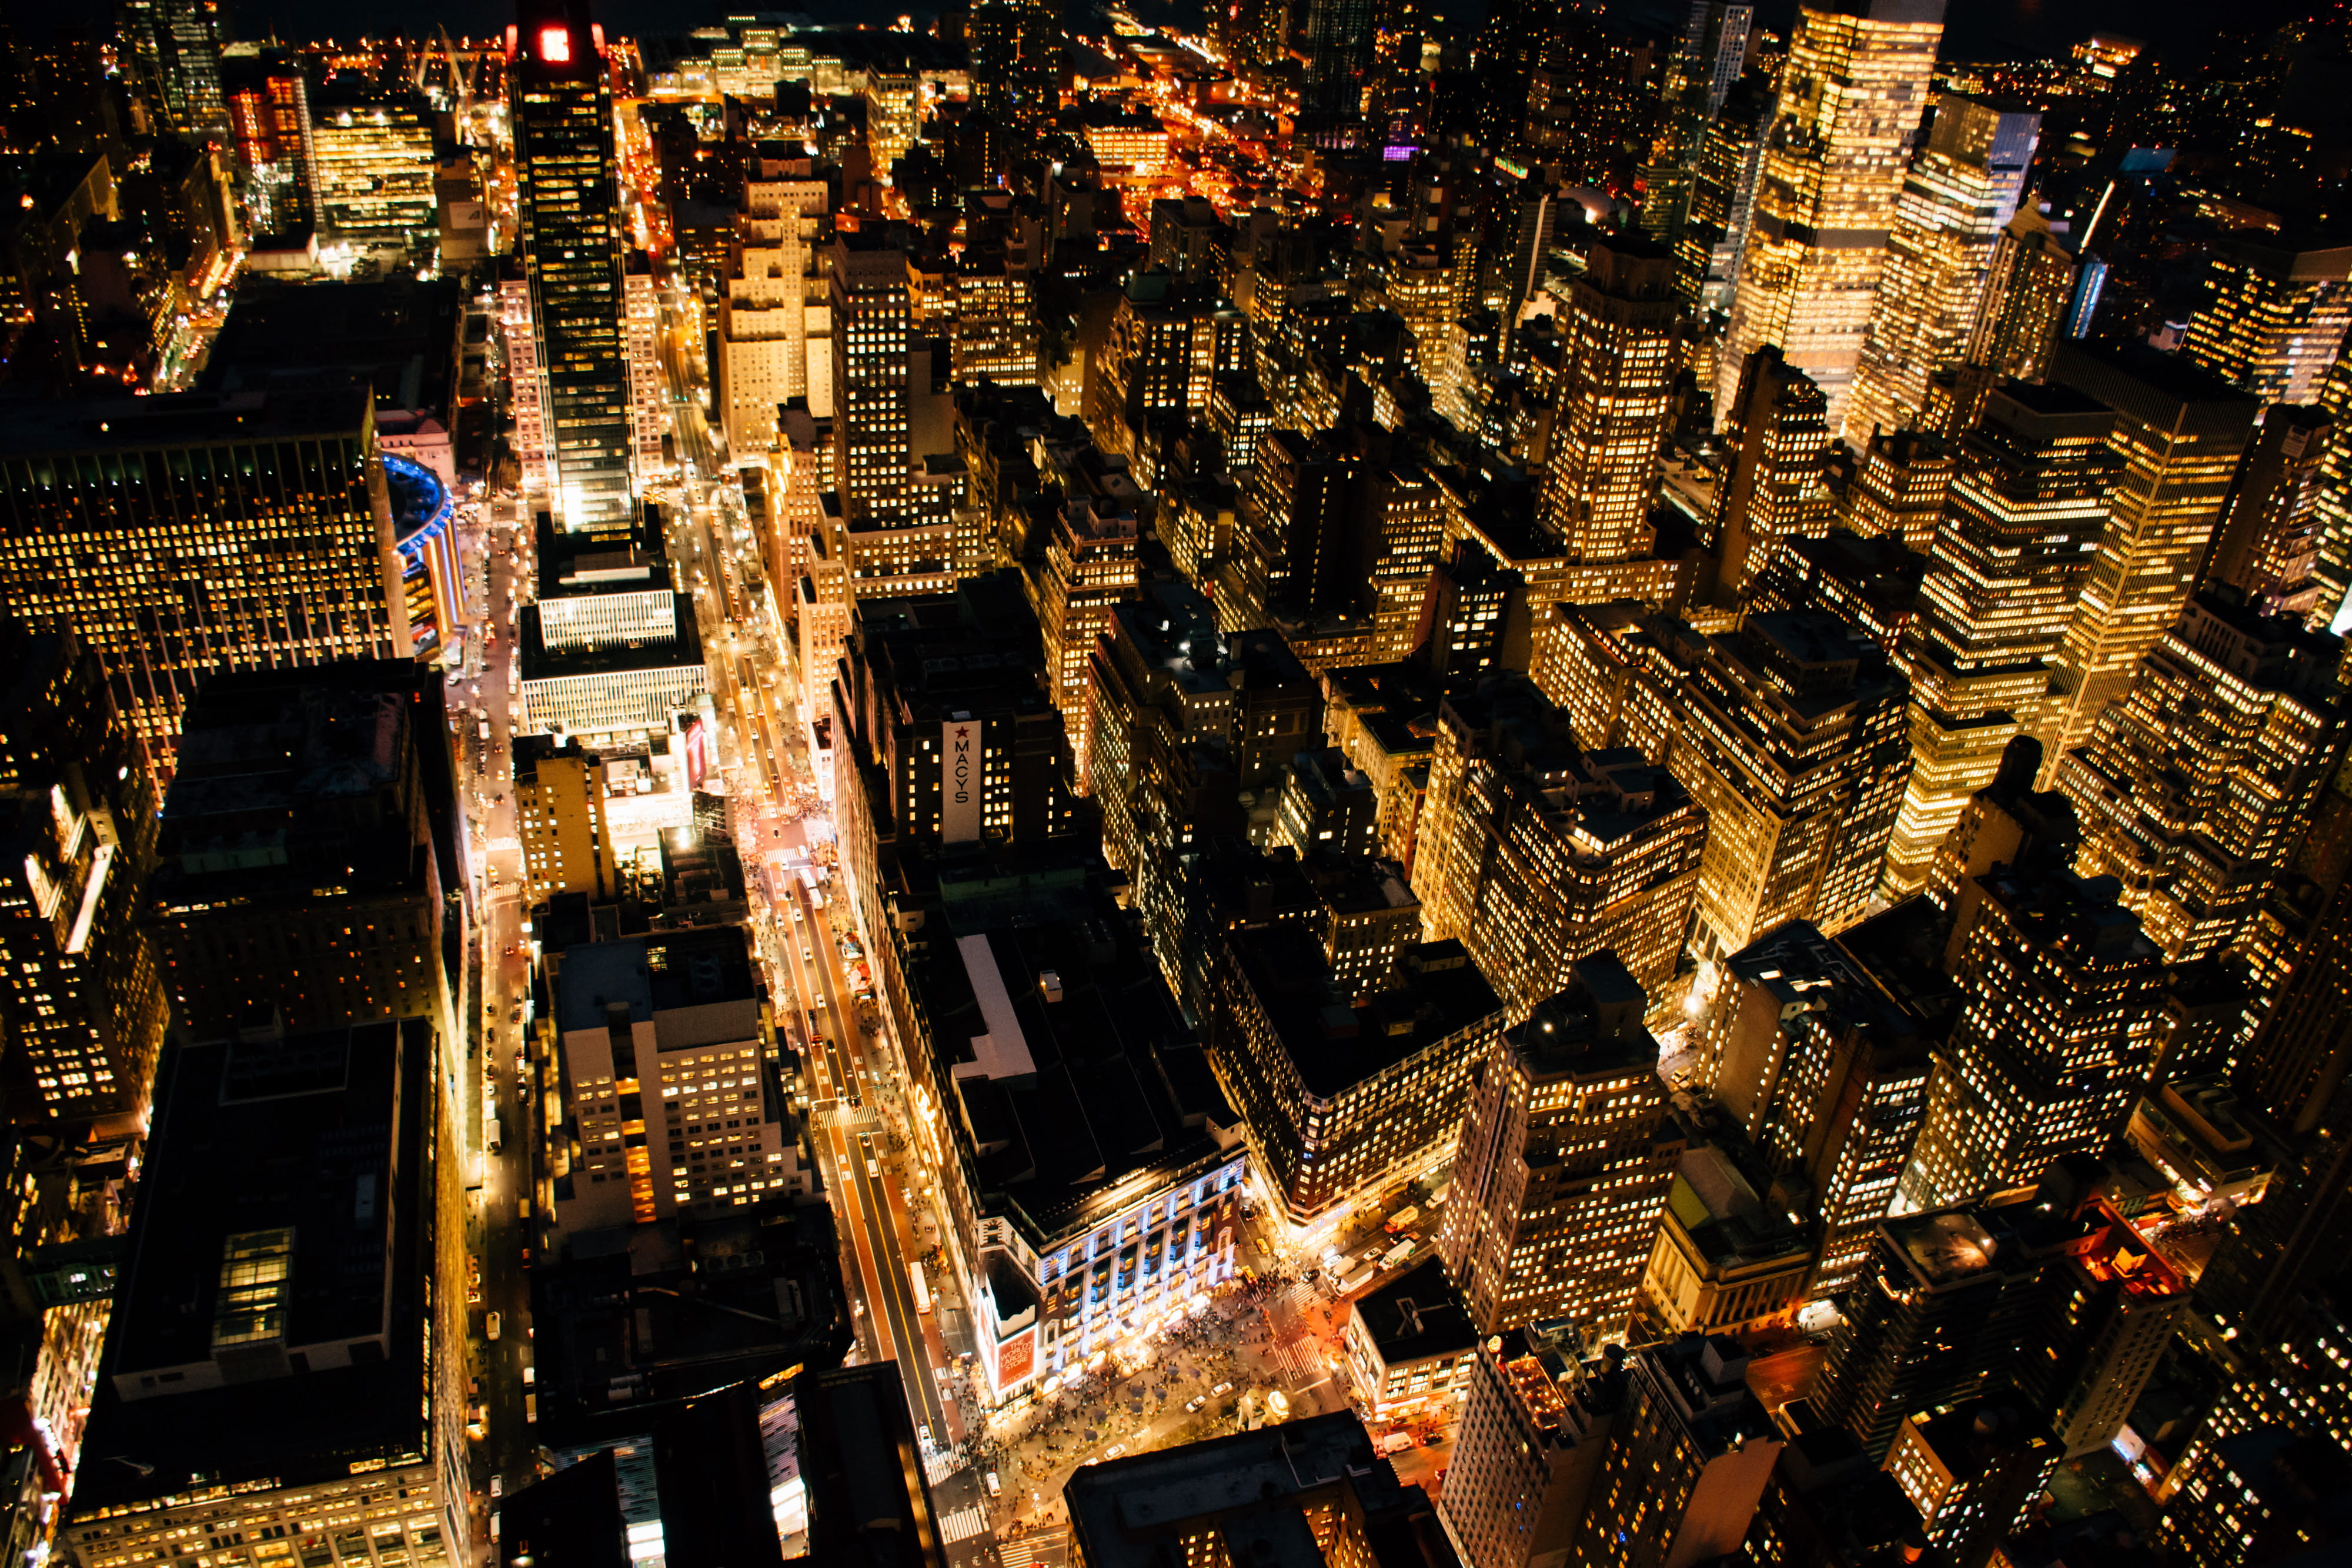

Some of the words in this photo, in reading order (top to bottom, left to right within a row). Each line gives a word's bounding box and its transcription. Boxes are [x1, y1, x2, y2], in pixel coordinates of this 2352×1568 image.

[955, 740, 969, 803] MACYS
[1000, 1339, 1034, 1362] WORLD'S
[1010, 1338, 1025, 1350] THE
[1000, 1348, 1031, 1368] LARGEST
[1005, 1355, 1028, 1372] STORE
